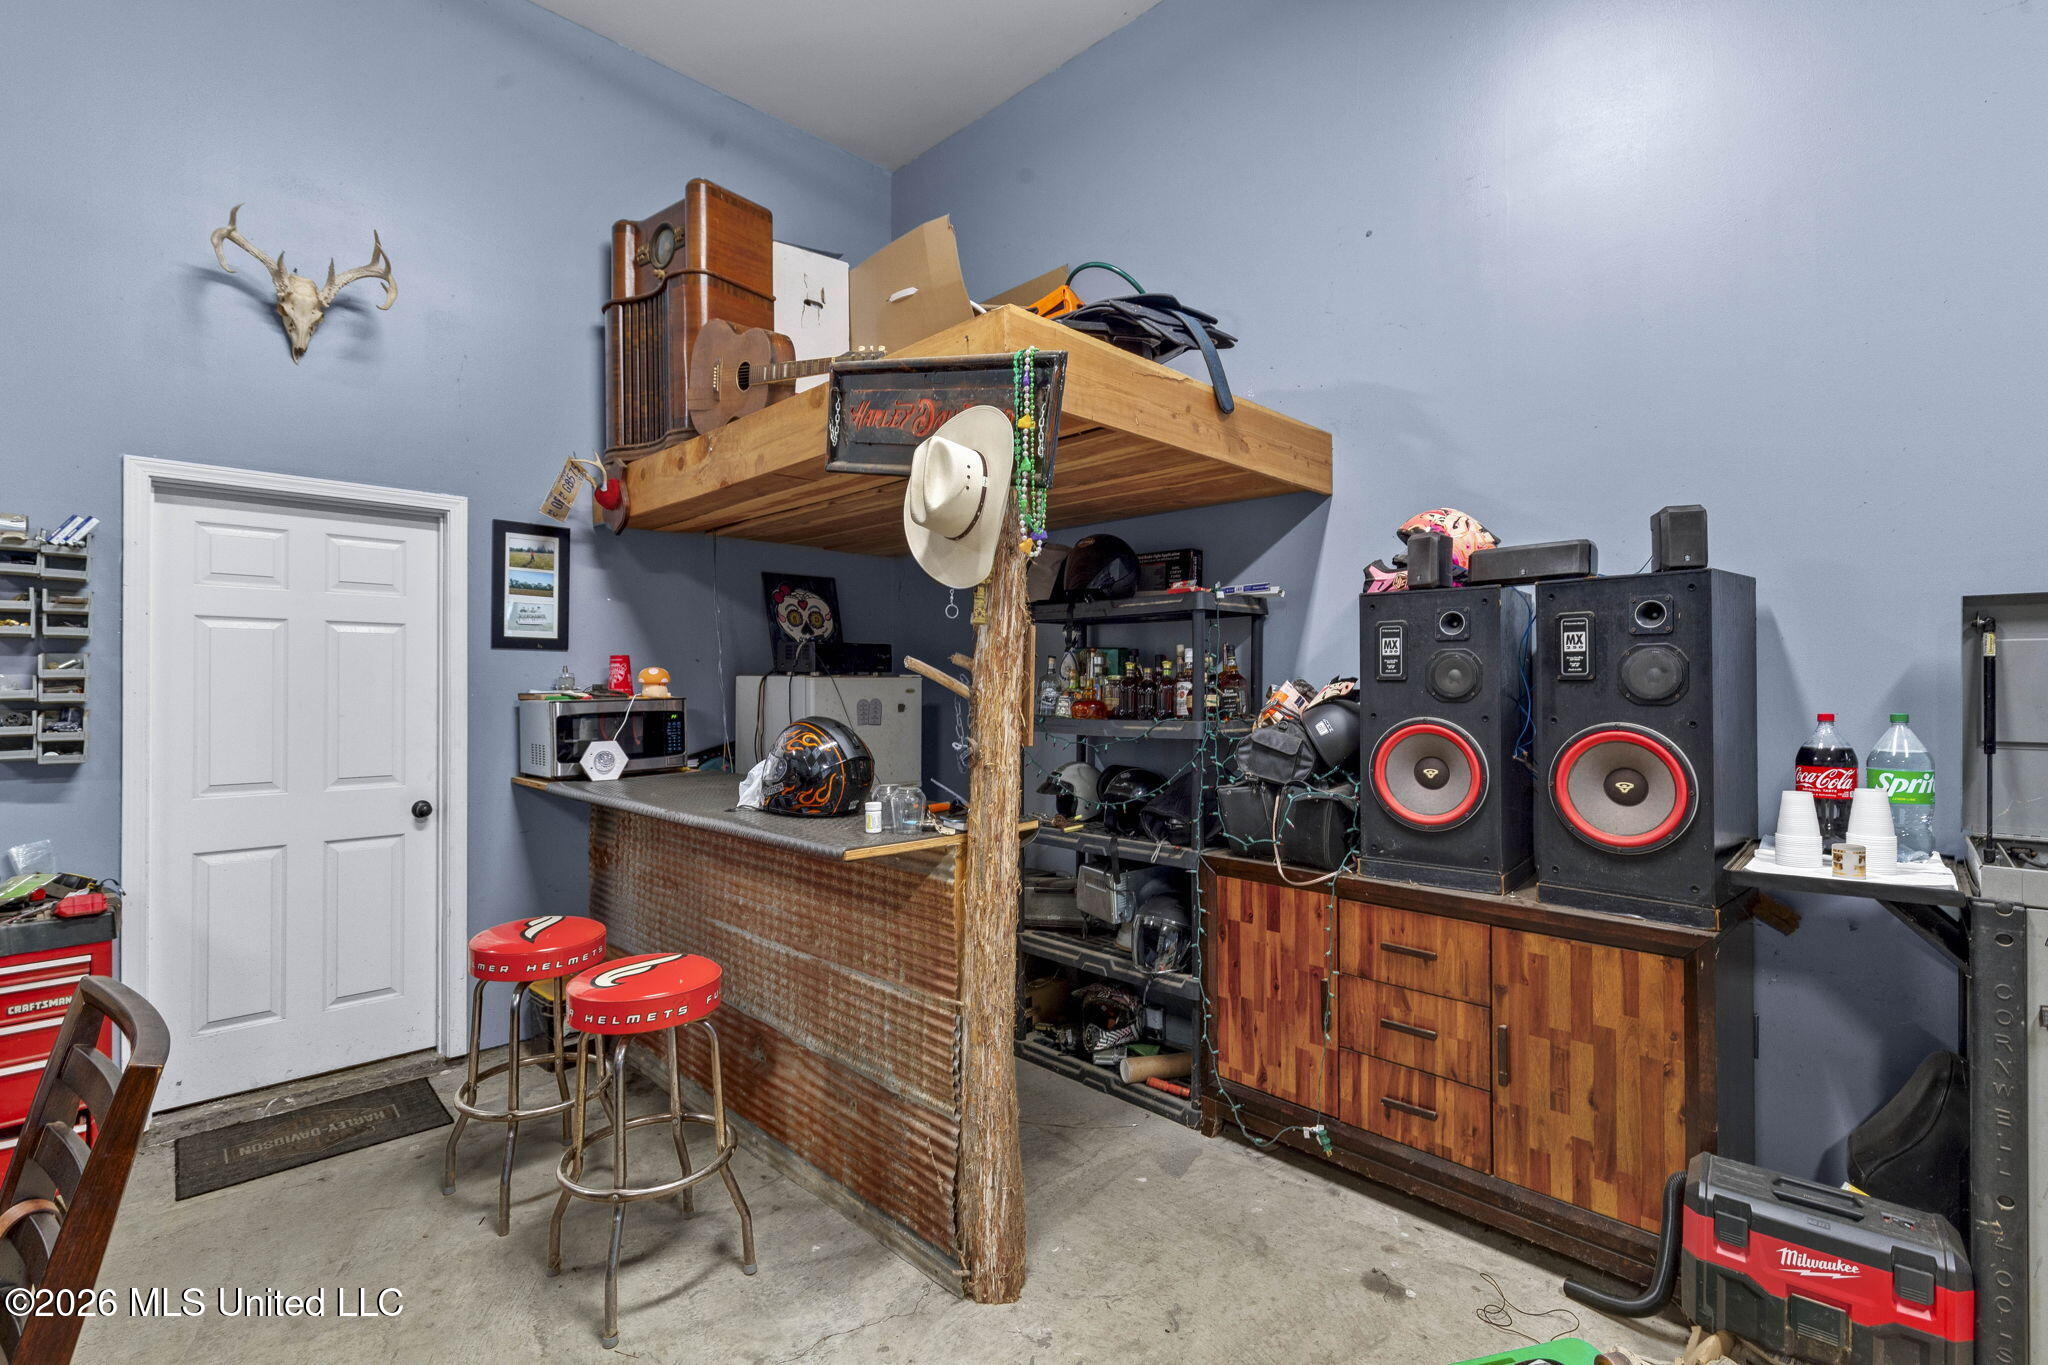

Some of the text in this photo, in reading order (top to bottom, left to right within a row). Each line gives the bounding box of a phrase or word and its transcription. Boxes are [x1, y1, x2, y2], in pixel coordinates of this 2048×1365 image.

[1383, 639, 1399, 650] MX
[1566, 633, 1584, 646] MX
[1795, 766, 1855, 790] Coca-Cola
[526, 945, 604, 973] HELMETS
[7, 995, 73, 1015] CRAFTSMAN
[584, 1005, 689, 1025] HELMETS
[1775, 1247, 1861, 1274] Milwaukee
